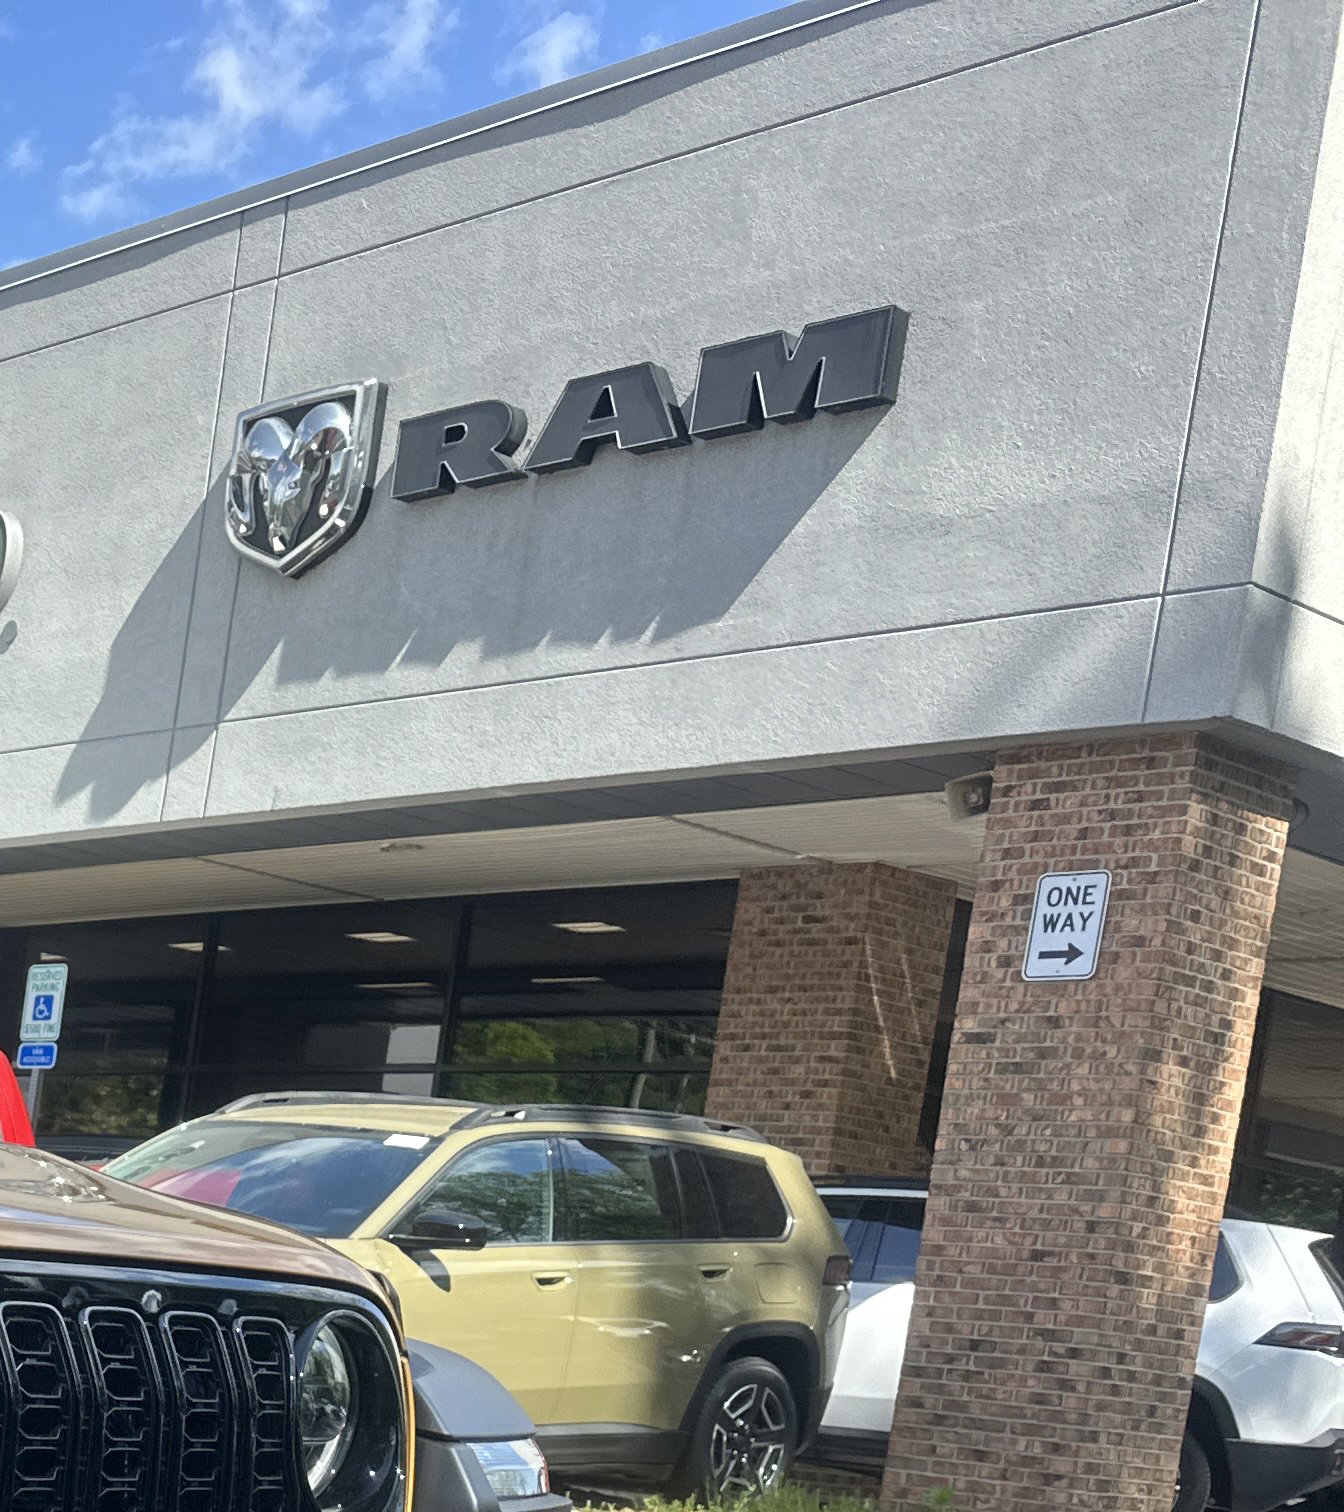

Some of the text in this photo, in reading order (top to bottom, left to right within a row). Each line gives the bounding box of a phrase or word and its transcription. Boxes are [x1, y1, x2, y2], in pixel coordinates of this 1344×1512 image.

[391, 304, 910, 502] RAM
[1046, 884, 1098, 908] ONE
[1042, 911, 1094, 934] WAY
